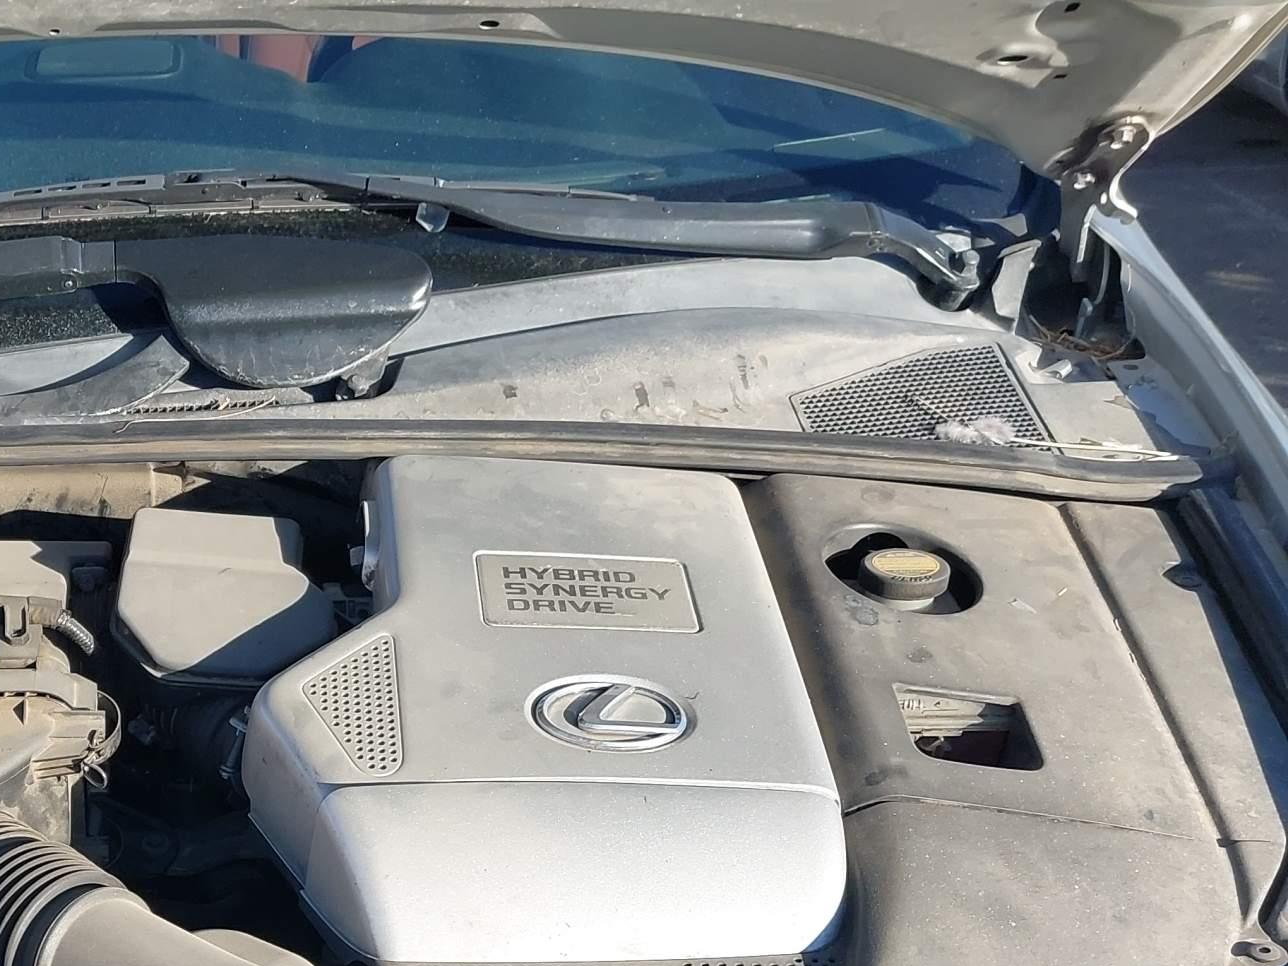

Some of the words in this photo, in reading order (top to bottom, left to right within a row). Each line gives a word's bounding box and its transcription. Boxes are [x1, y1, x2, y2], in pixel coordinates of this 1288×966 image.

[502, 566, 636, 583] HYBRID
[504, 582, 672, 600] SYNERGY
[506, 598, 616, 615] DRIVE
